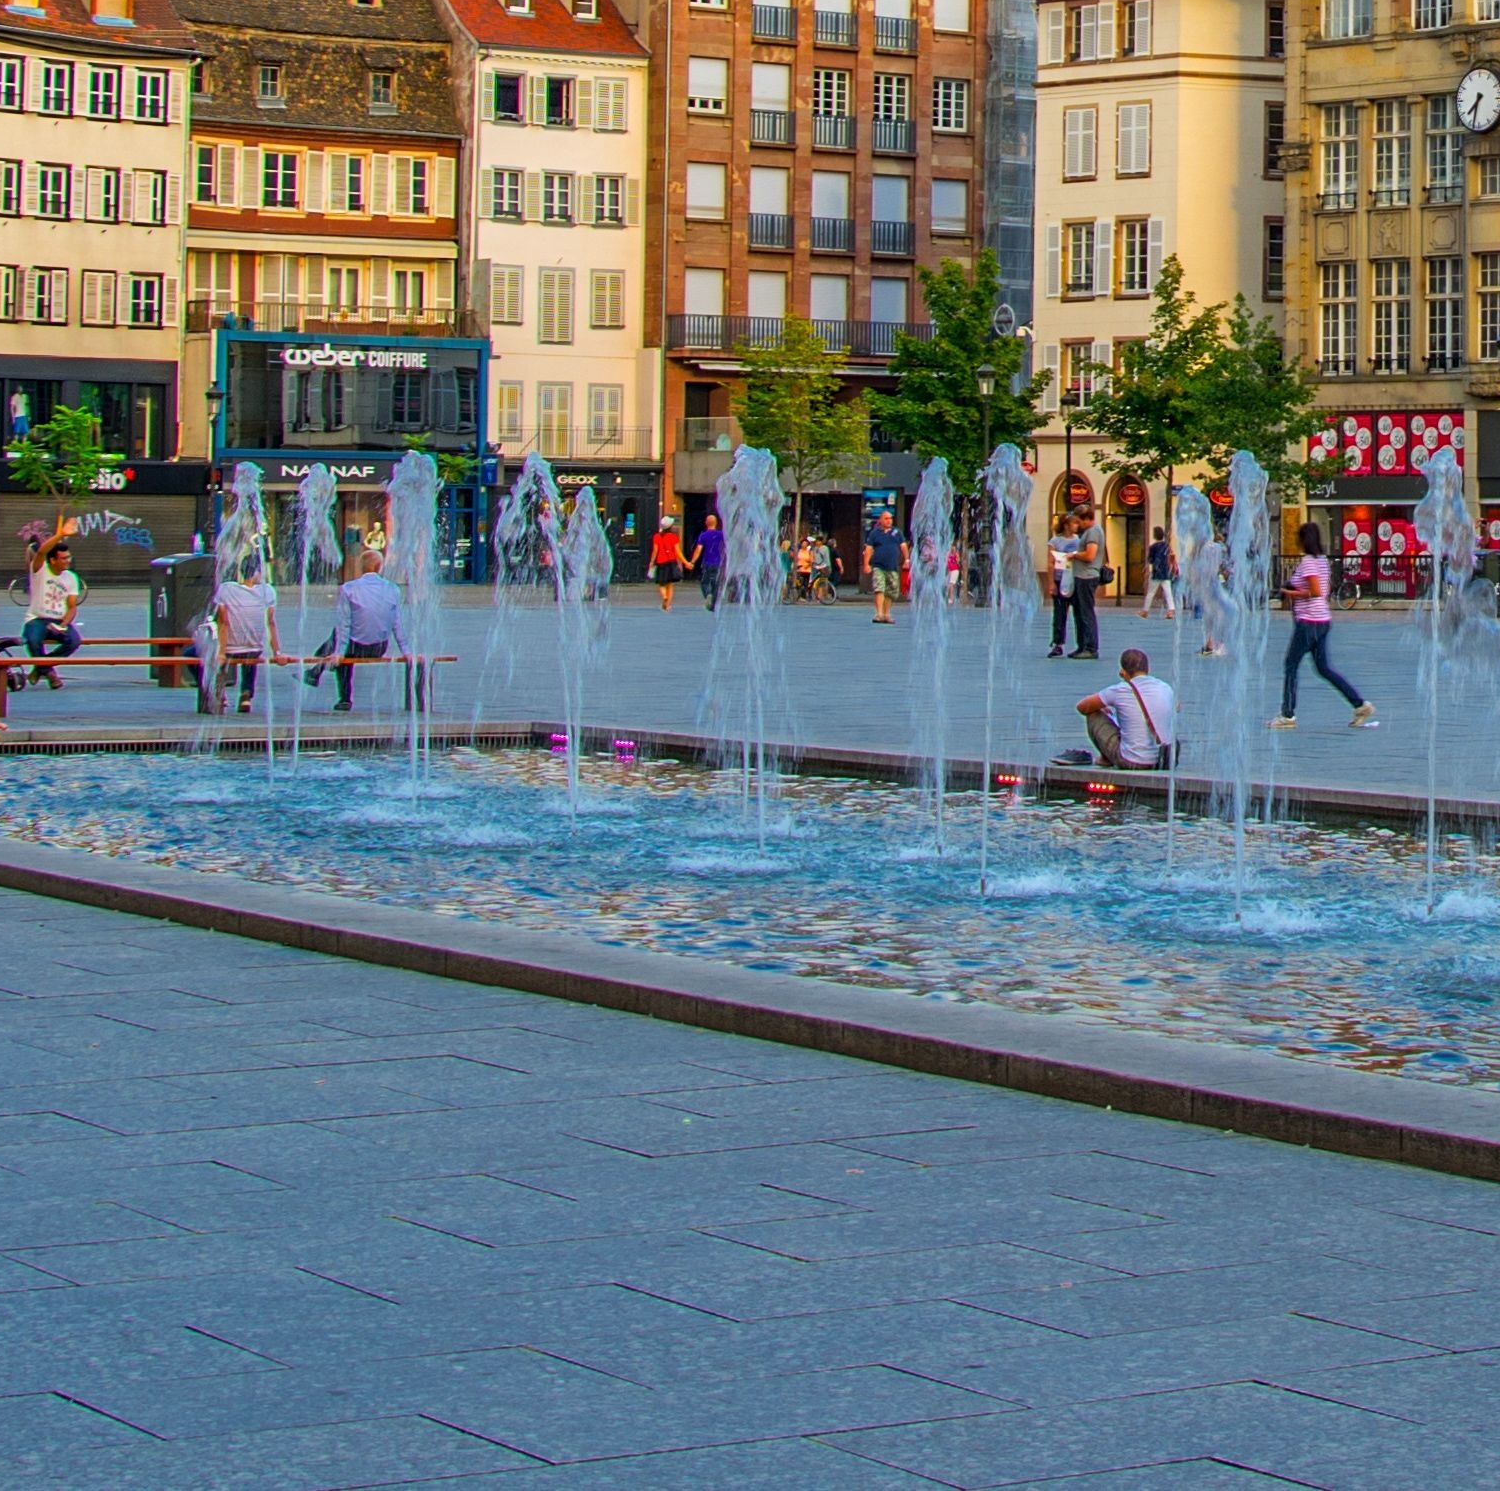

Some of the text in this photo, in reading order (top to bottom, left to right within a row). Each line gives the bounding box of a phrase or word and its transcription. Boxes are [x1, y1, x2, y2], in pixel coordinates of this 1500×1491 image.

[368, 352, 428, 368] COIFFURE
[281, 465, 376, 477] NA NAF
[557, 474, 598, 485] GEOX
